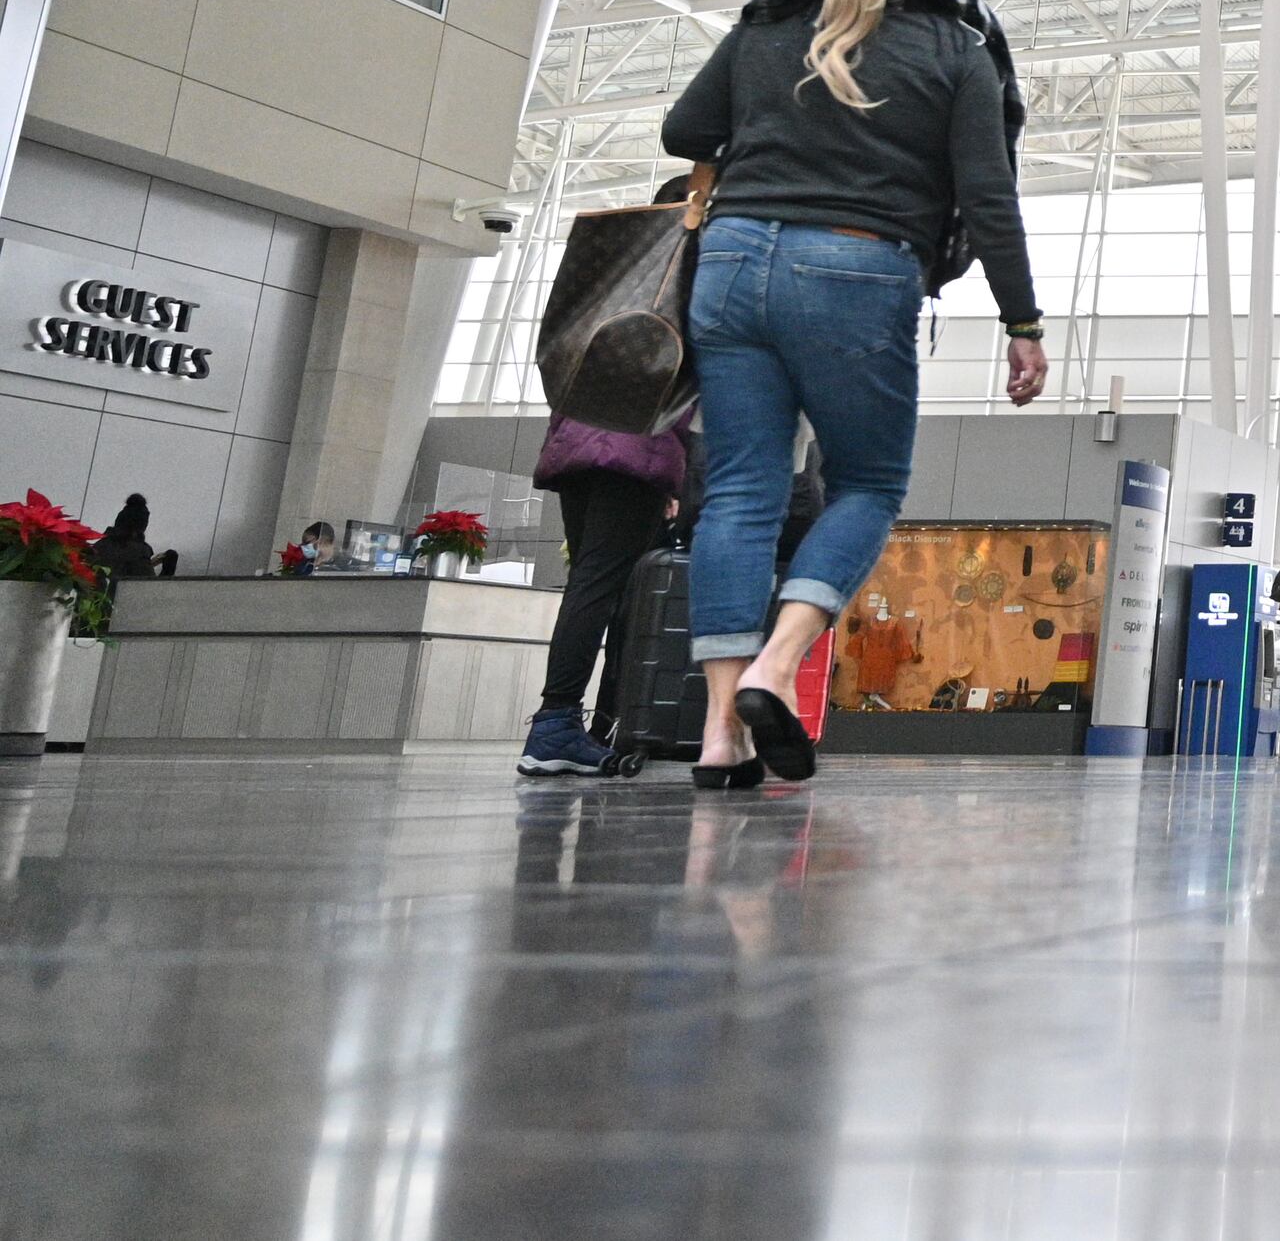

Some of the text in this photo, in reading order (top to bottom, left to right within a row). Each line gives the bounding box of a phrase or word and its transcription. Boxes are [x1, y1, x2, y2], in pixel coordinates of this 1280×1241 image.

[77, 279, 201, 332] GUEST
[41, 316, 213, 380] SERVICES
[1233, 498, 1245, 513] 4
